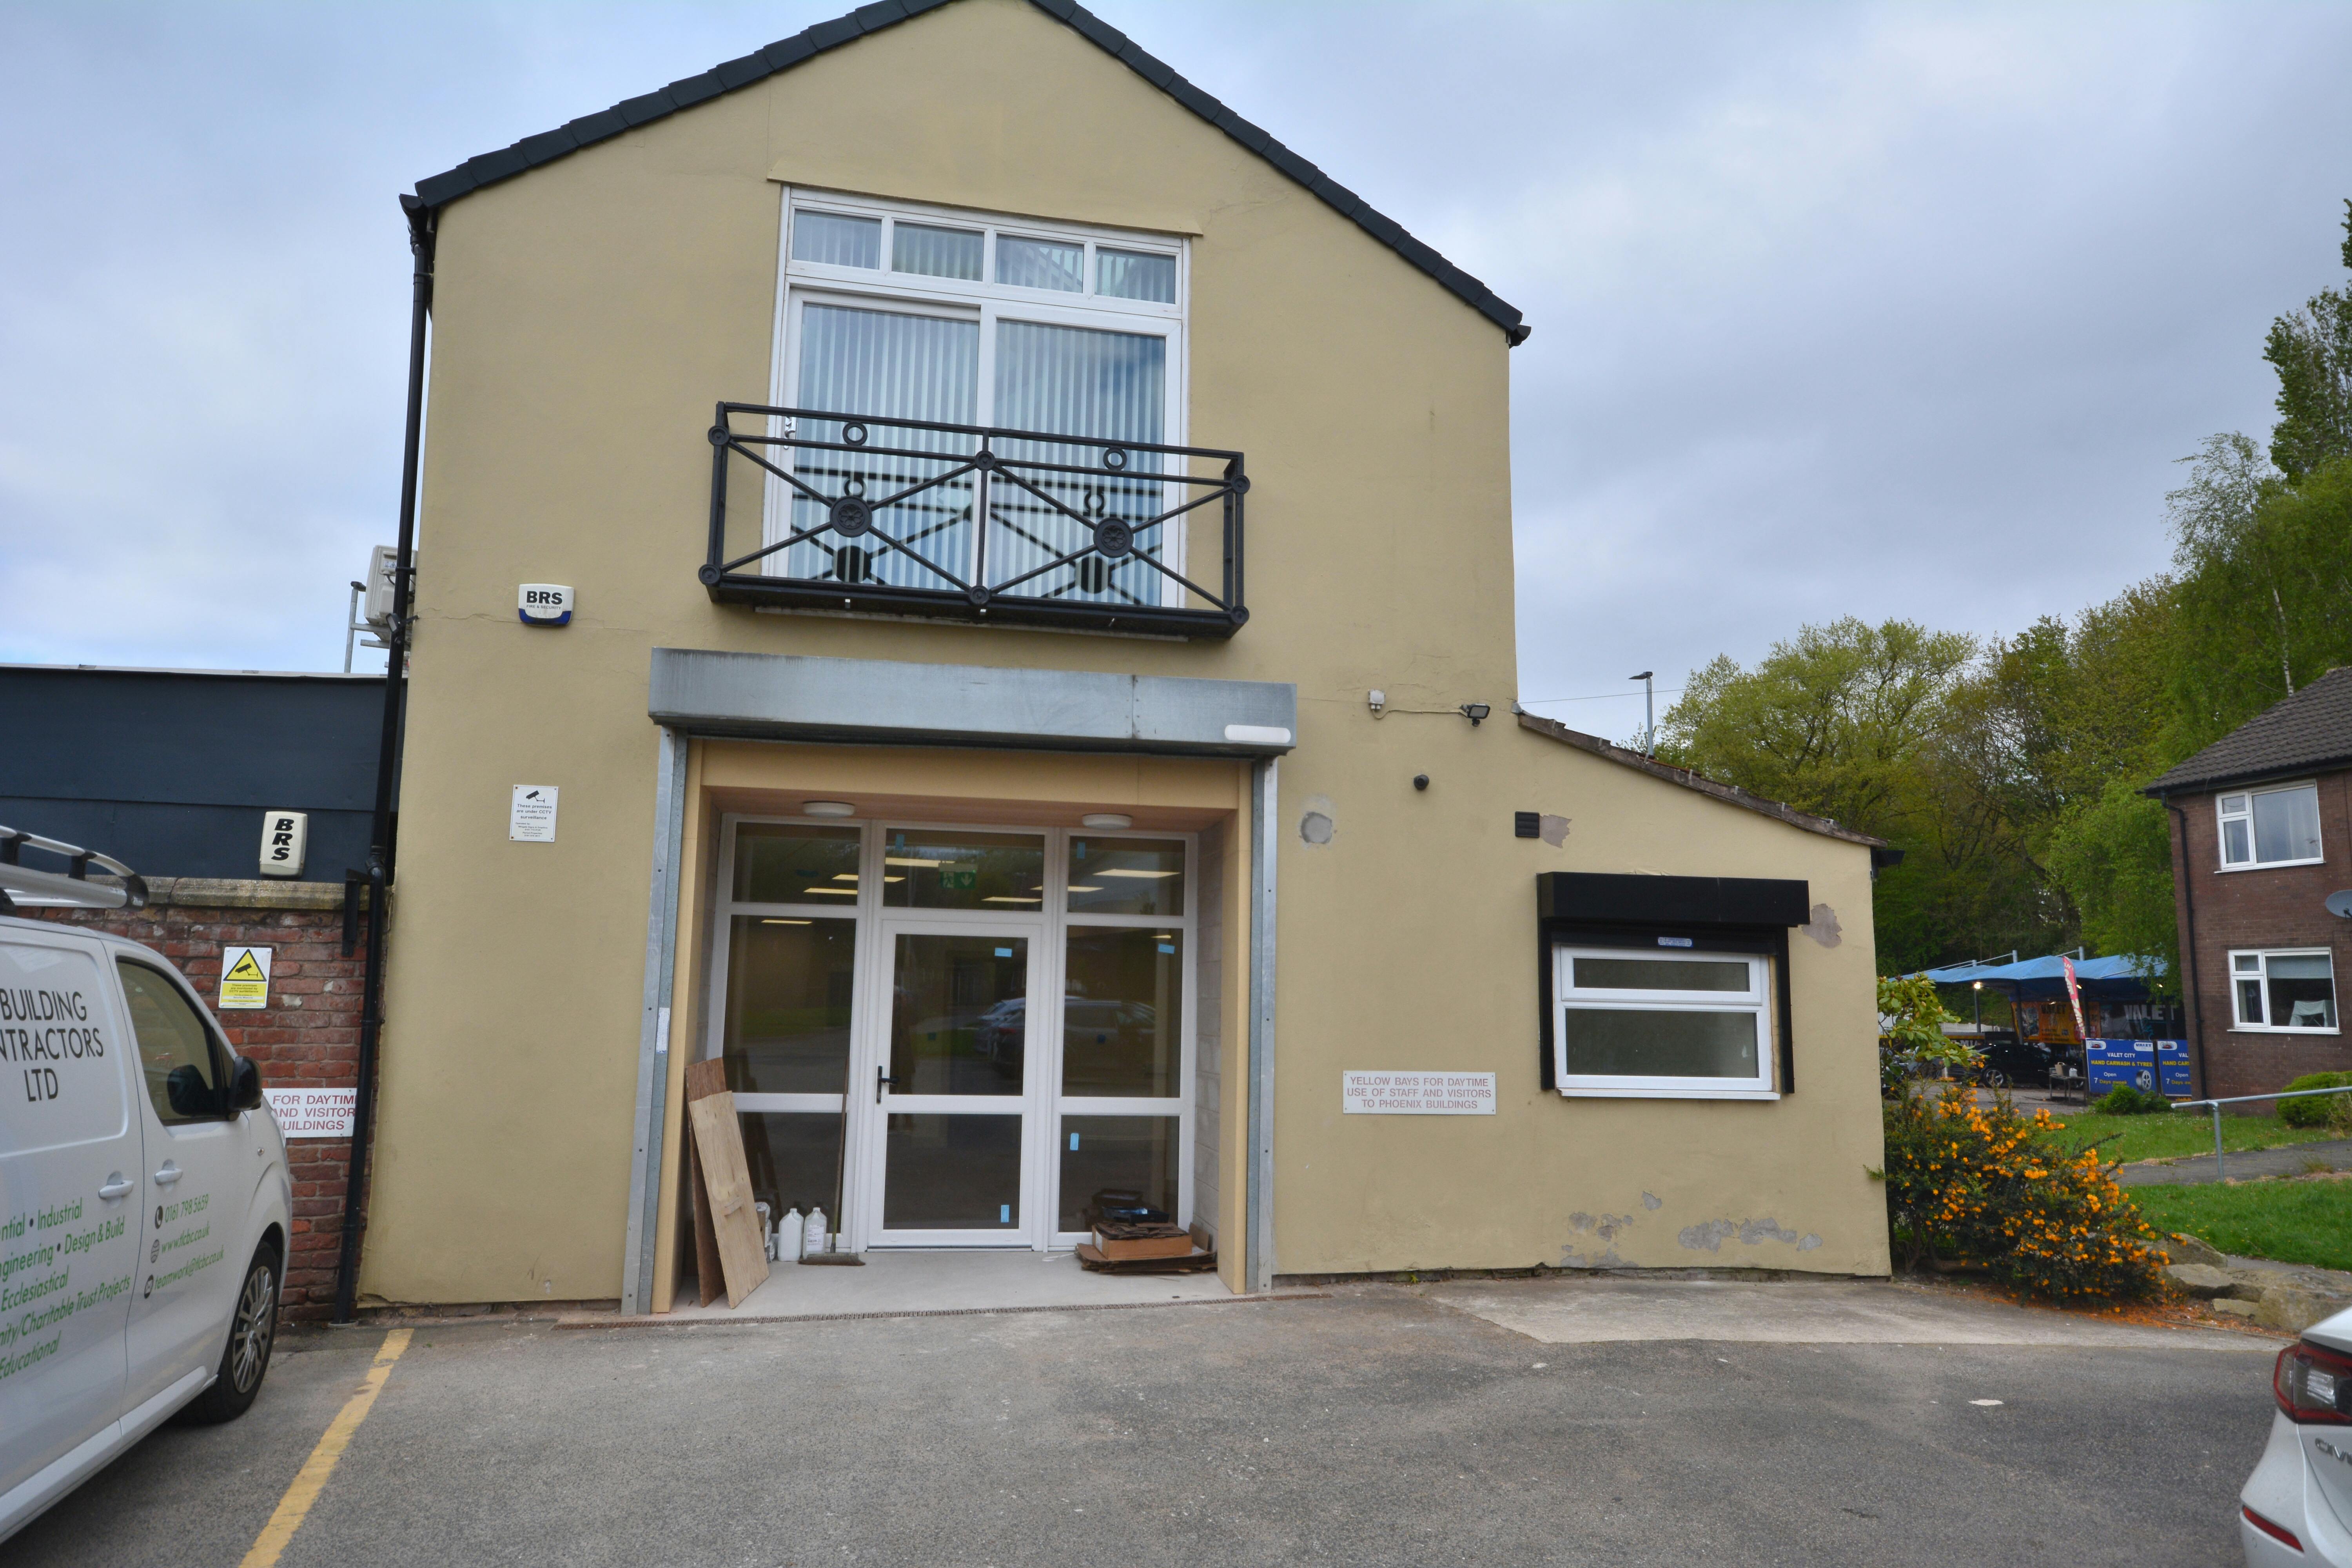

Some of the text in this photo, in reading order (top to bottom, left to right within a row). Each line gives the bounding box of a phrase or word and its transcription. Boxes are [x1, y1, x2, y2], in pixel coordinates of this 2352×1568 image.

[526, 591, 563, 604] BRS
[271, 818, 294, 861] BRS
[0, 988, 87, 1021] BUILDING
[2124, 1005, 2178, 1020] VALET
[24, 1068, 58, 1102] LTD
[1347, 1088, 1491, 1098] USE OF STAFF AND VISITORS
[1351, 1077, 1390, 1085] YELLOW
[1448, 1078, 1488, 1087] DAYTIME
[273, 1095, 300, 1105] FOR
[1362, 1099, 1477, 1109] TO PHOENIX BUILDINGS
[0, 1198, 82, 1241] ntial Industrial
[165, 1194, 209, 1223] 0161 798 5659
[64, 1229, 96, 1254] Design
[98, 1223, 103, 1243] &
[105, 1215, 125, 1240] Build
[162, 1220, 210, 1254] www.tlcbc.co.uk
[154, 1245, 225, 1290] teamwork@tlcbc.co.uk
[1, 1265, 69, 1312] Ecclesiastical
[76, 1287, 98, 1312] Trust
[98, 1274, 131, 1302] Projects
[0, 1330, 62, 1380] Educational
